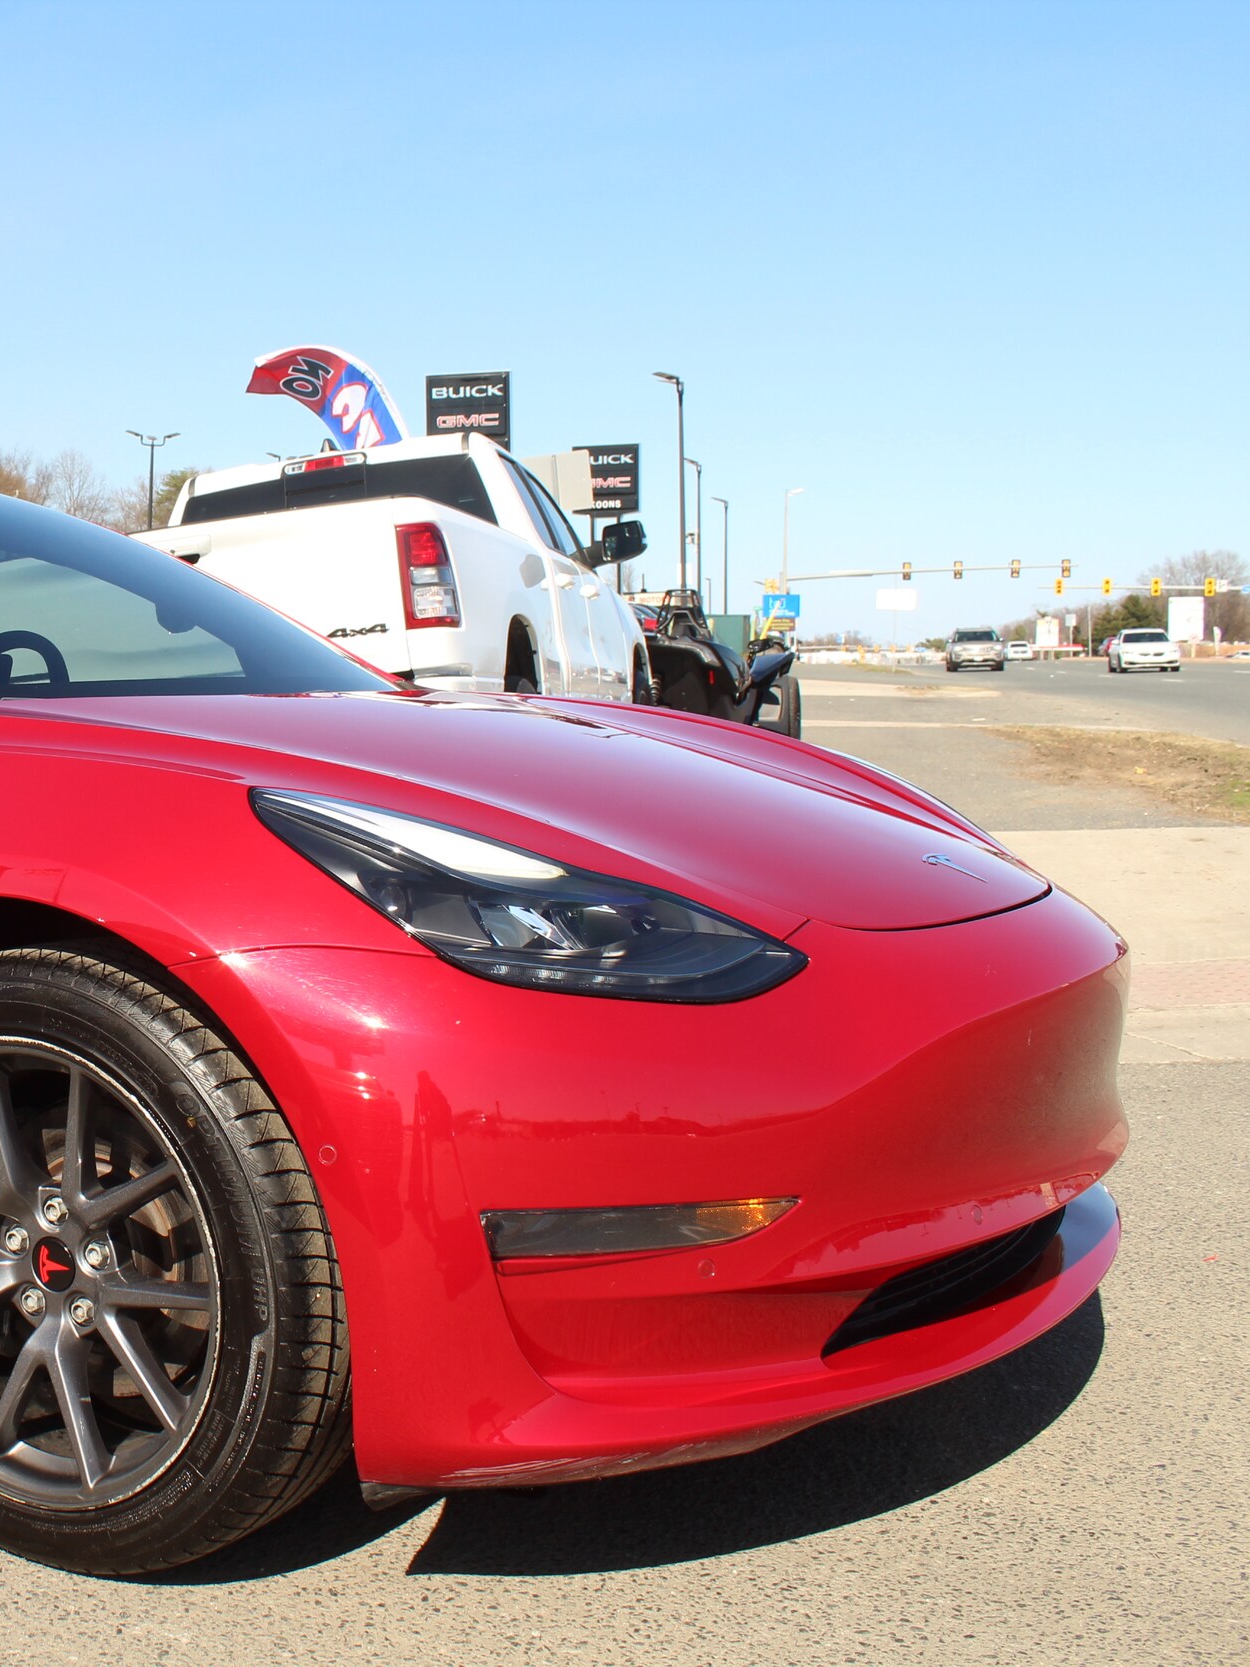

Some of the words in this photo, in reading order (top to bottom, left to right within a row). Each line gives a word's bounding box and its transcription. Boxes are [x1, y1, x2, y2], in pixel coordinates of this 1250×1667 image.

[431, 384, 504, 399] BUICK
[436, 413, 500, 428] GMC
[590, 454, 634, 465] UICK
[326, 623, 390, 639] 4x4
